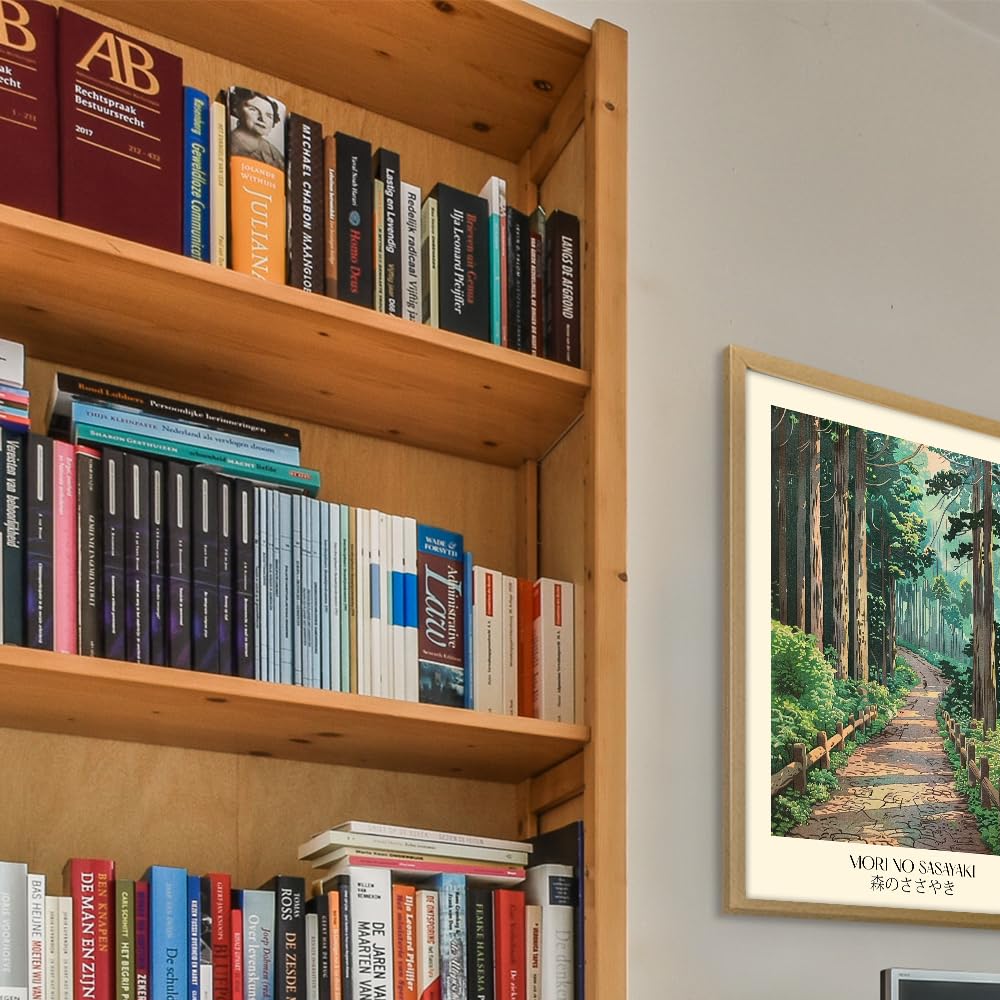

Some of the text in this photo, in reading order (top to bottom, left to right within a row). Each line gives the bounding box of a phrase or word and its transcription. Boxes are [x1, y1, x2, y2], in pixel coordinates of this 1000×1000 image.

[76, 31, 160, 97] AB
[75, 84, 137, 116] Rechtspraak
[75, 95, 145, 129] Bestuursrecht
[75, 124, 94, 137] 2017
[302, 123, 313, 177] MICHAEL
[191, 142, 206, 197] Geweldloze
[302, 180, 313, 230] CHABON
[385, 168, 396, 254] Lastig en Levendig
[449, 208, 465, 226] Ilja
[349, 228, 361, 294] Homo Deus
[406, 192, 417, 308] Redelijk radicaal Vijftig
[453, 226, 465, 271] Leonard
[561, 235, 574, 264] LANGS
[562, 264, 573, 275] DE
[562, 276, 574, 320] AFGROND
[150, 399, 266, 433] Persoonlijke herinneringen
[162, 425, 201, 440] Nederland
[202, 433, 213, 442] als
[4, 440, 20, 548] Vereisten van behoorlijkheid
[424, 544, 457, 558] FORSYTH
[425, 536, 446, 549] WADE
[425, 563, 462, 649] Law
[447, 565, 459, 650] Administrative
[81, 872, 94, 891] DE
[850, 855, 975, 878] MORI NO SASAYAKI
[32, 880, 41, 899] BAS
[871, 875, 954, 896] 森のささやき
[32, 903, 41, 936] HEIJNE
[81, 896, 95, 935] MAN
[97, 872, 108, 951] BEN KNAPEN
[281, 888, 292, 920] ROSS
[427, 895, 435, 944] DE ONTSPORING
[248, 914, 259, 942] Over
[285, 932, 295, 950] DE
[372, 922, 385, 936] DE
[405, 895, 414, 991] Ilja Leonard Pfeijffer
[555, 930, 571, 949] De
[32, 940, 42, 969] MOETEN
[82, 938, 95, 958] EN
[121, 942, 129, 959] HET
[166, 948, 178, 964] De
[358, 921, 371, 973] MAARTEN
[373, 943, 386, 978] JAREN
[32, 971, 42, 984] WIJ
[80, 962, 95, 998] ZIJN
[121, 960, 129, 991] BEGRIP
[286, 956, 296, 992] ZESDE
[476, 941, 484, 992] HALSEMA
[510, 970, 517, 980] De
[32, 986, 42, 1000] VAN
[137, 974, 146, 1000] ZEKER
[359, 980, 372, 1000] VAN
